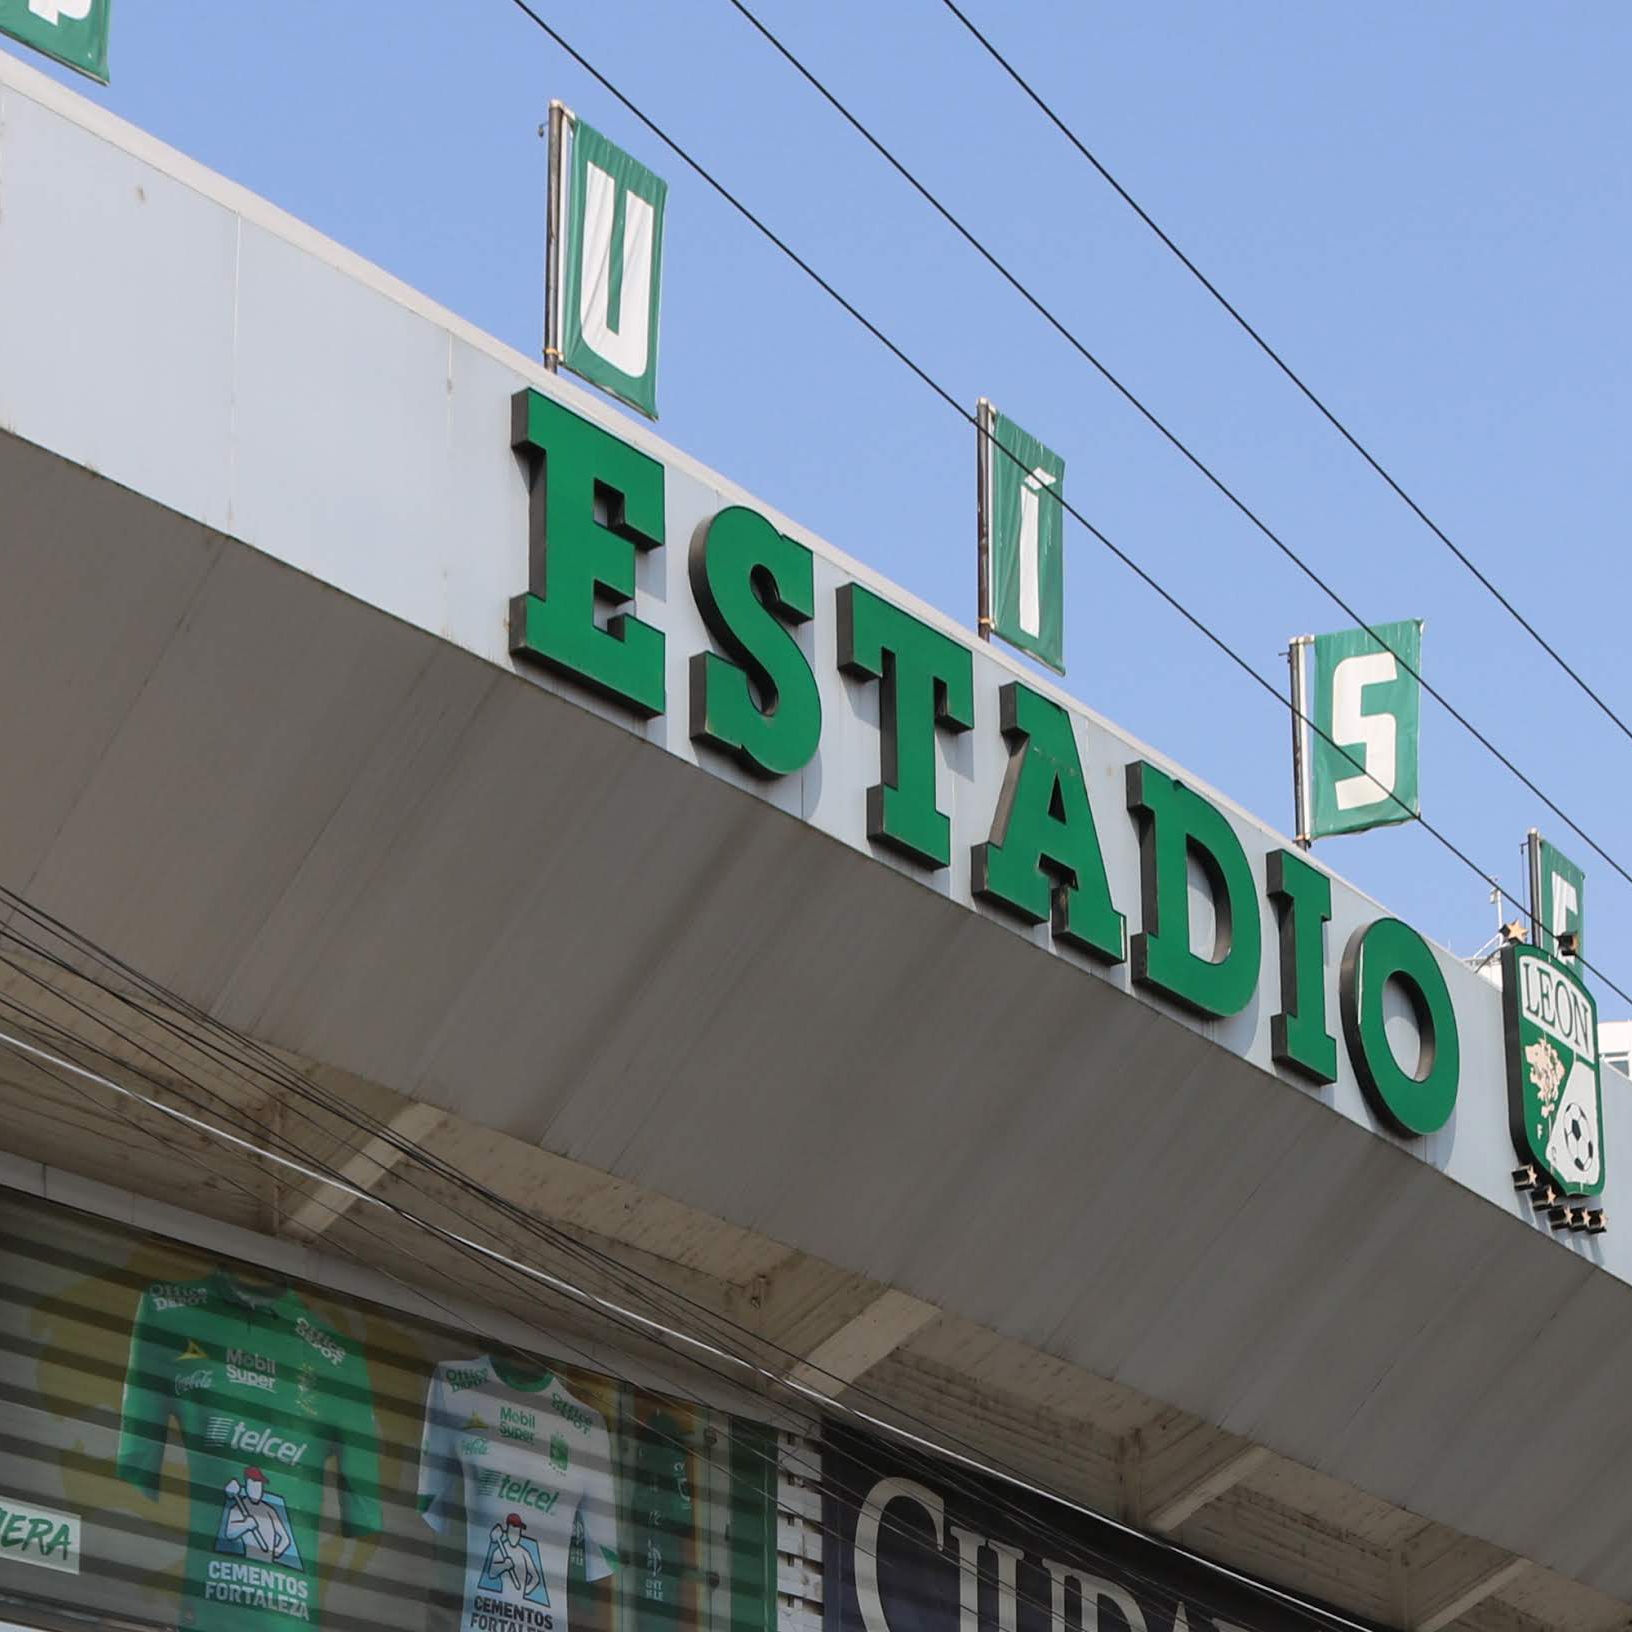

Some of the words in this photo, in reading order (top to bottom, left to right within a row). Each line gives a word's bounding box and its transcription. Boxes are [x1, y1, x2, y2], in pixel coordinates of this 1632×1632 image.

[579, 161, 655, 380] U
[1333, 652, 1398, 811] S
[510, 388, 1460, 1139] ESTADIO
[1523, 963, 1591, 1053] LEON
[226, 1349, 276, 1374] Mobil
[226, 1365, 276, 1391] Super
[500, 1407, 535, 1428] Mobil
[231, 1420, 308, 1466] telcel
[497, 1473, 560, 1514] telcel
[208, 1560, 308, 1599] CEMENTOS
[205, 1581, 310, 1621] FORTALEZA
[474, 1596, 553, 1630] CEMENTOS
